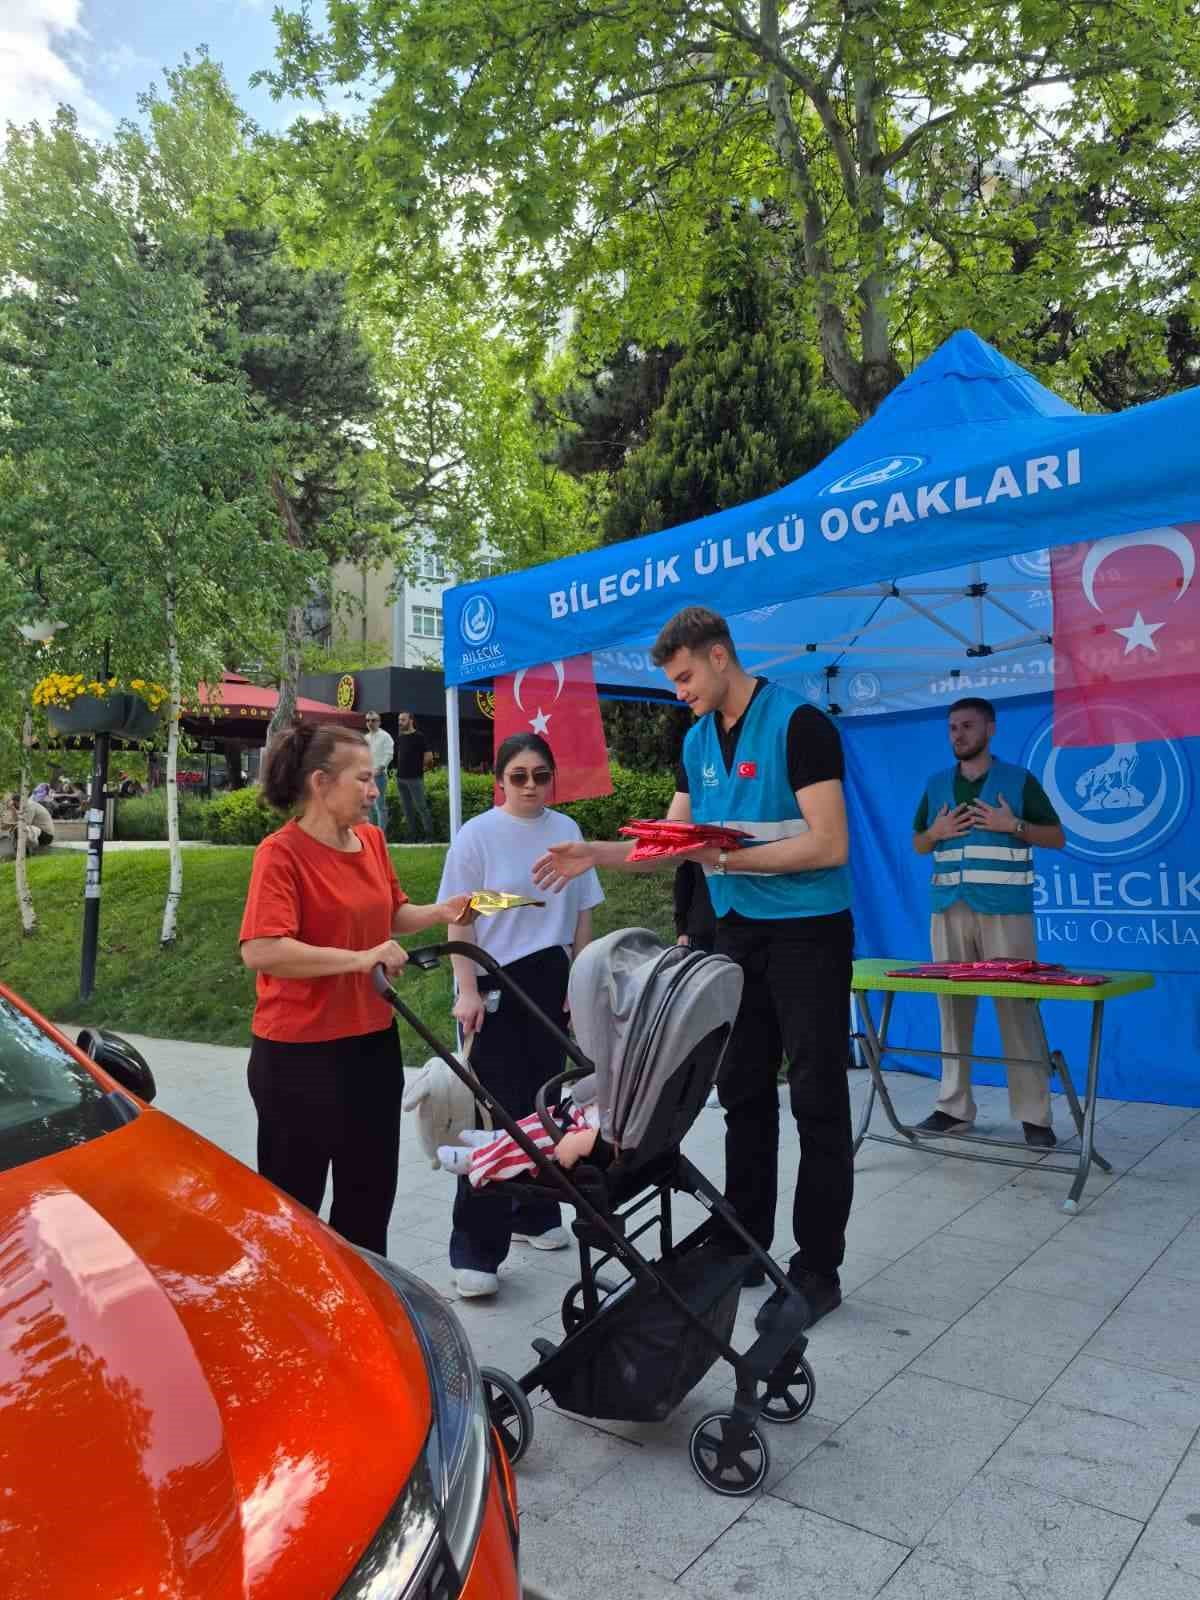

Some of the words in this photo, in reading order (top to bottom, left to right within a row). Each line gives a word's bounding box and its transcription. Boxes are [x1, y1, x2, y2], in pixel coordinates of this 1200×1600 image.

[549, 555, 680, 619] BİLECİK
[693, 513, 805, 575] ÜLKÜ
[820, 448, 1081, 542] OCAKLARI
[1033, 862, 1200, 906] BİLECİK
[1036, 917, 1079, 942] lkü
